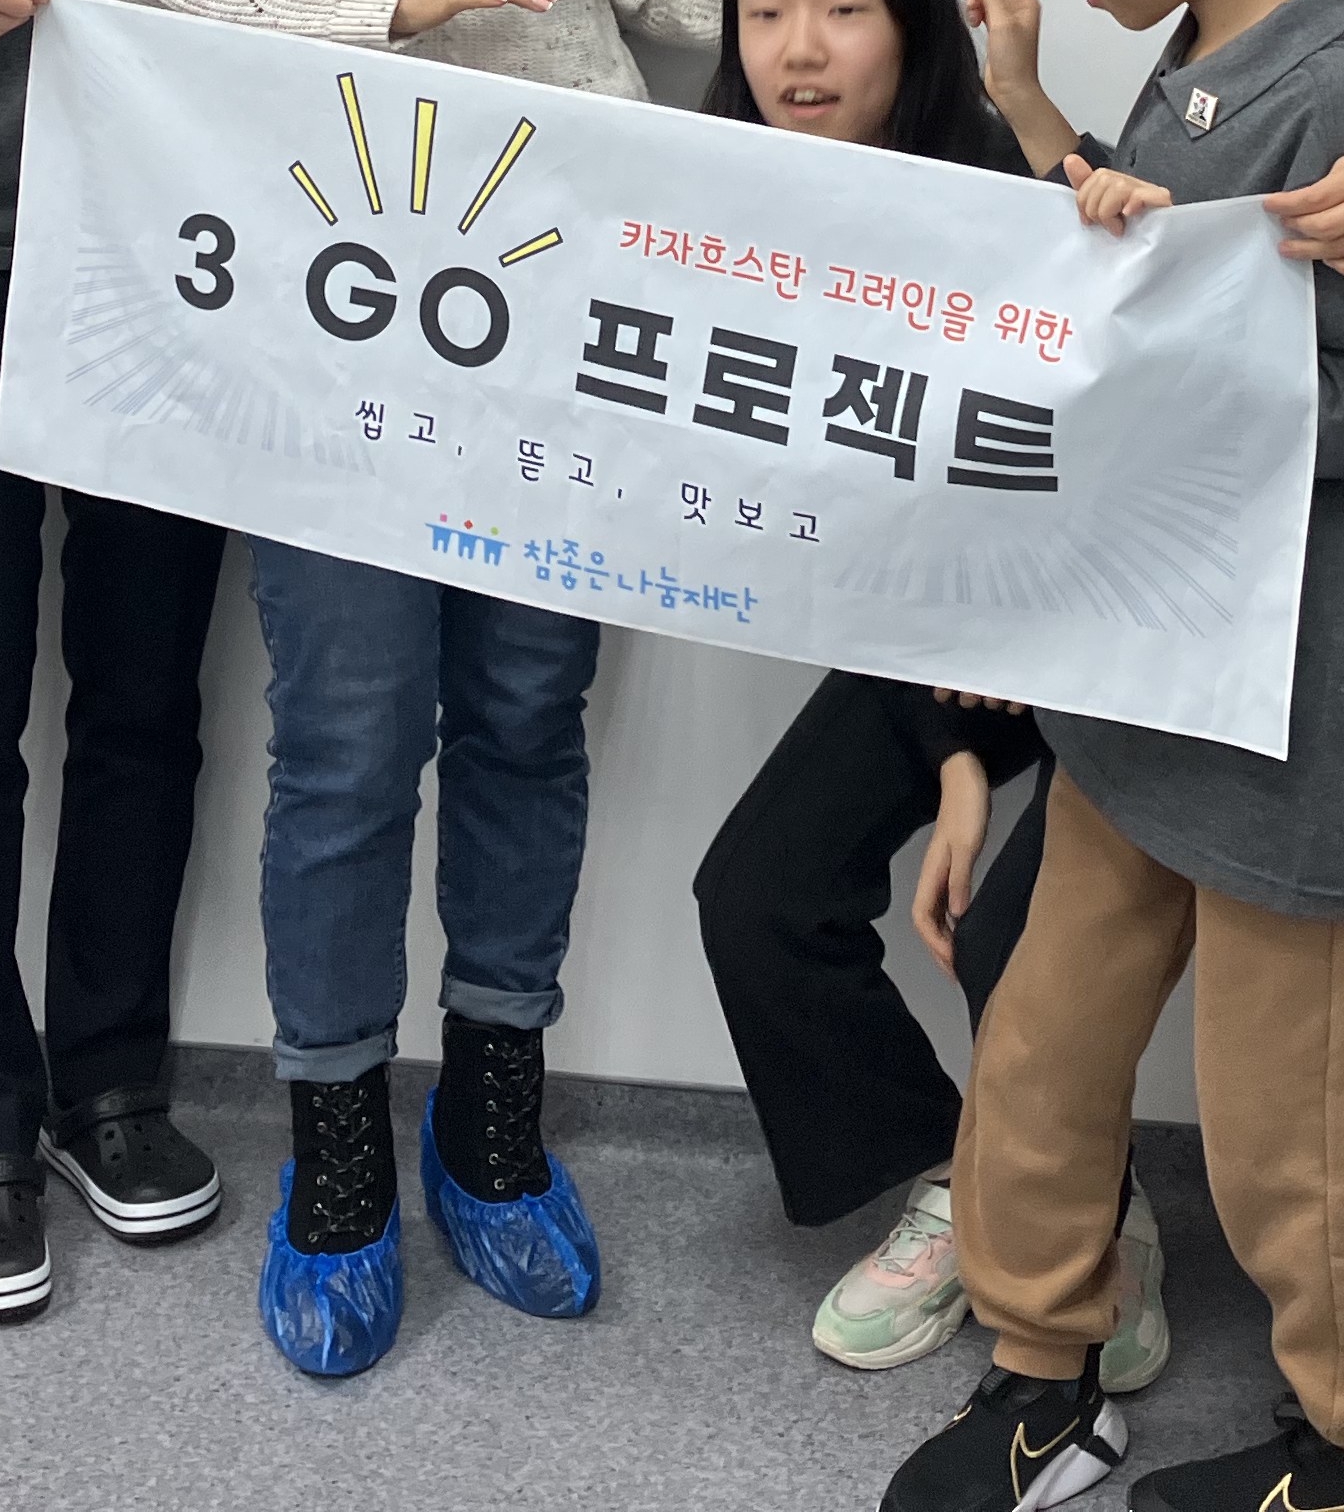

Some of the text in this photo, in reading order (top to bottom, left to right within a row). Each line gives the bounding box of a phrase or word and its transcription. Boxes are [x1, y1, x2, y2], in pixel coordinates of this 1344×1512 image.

[174, 212, 1060, 494] 3 GO 프로젝트
[619, 220, 1074, 364] 카자흐스탄 고려인을 위한
[522, 539, 759, 624] 참좋은나눔재단
